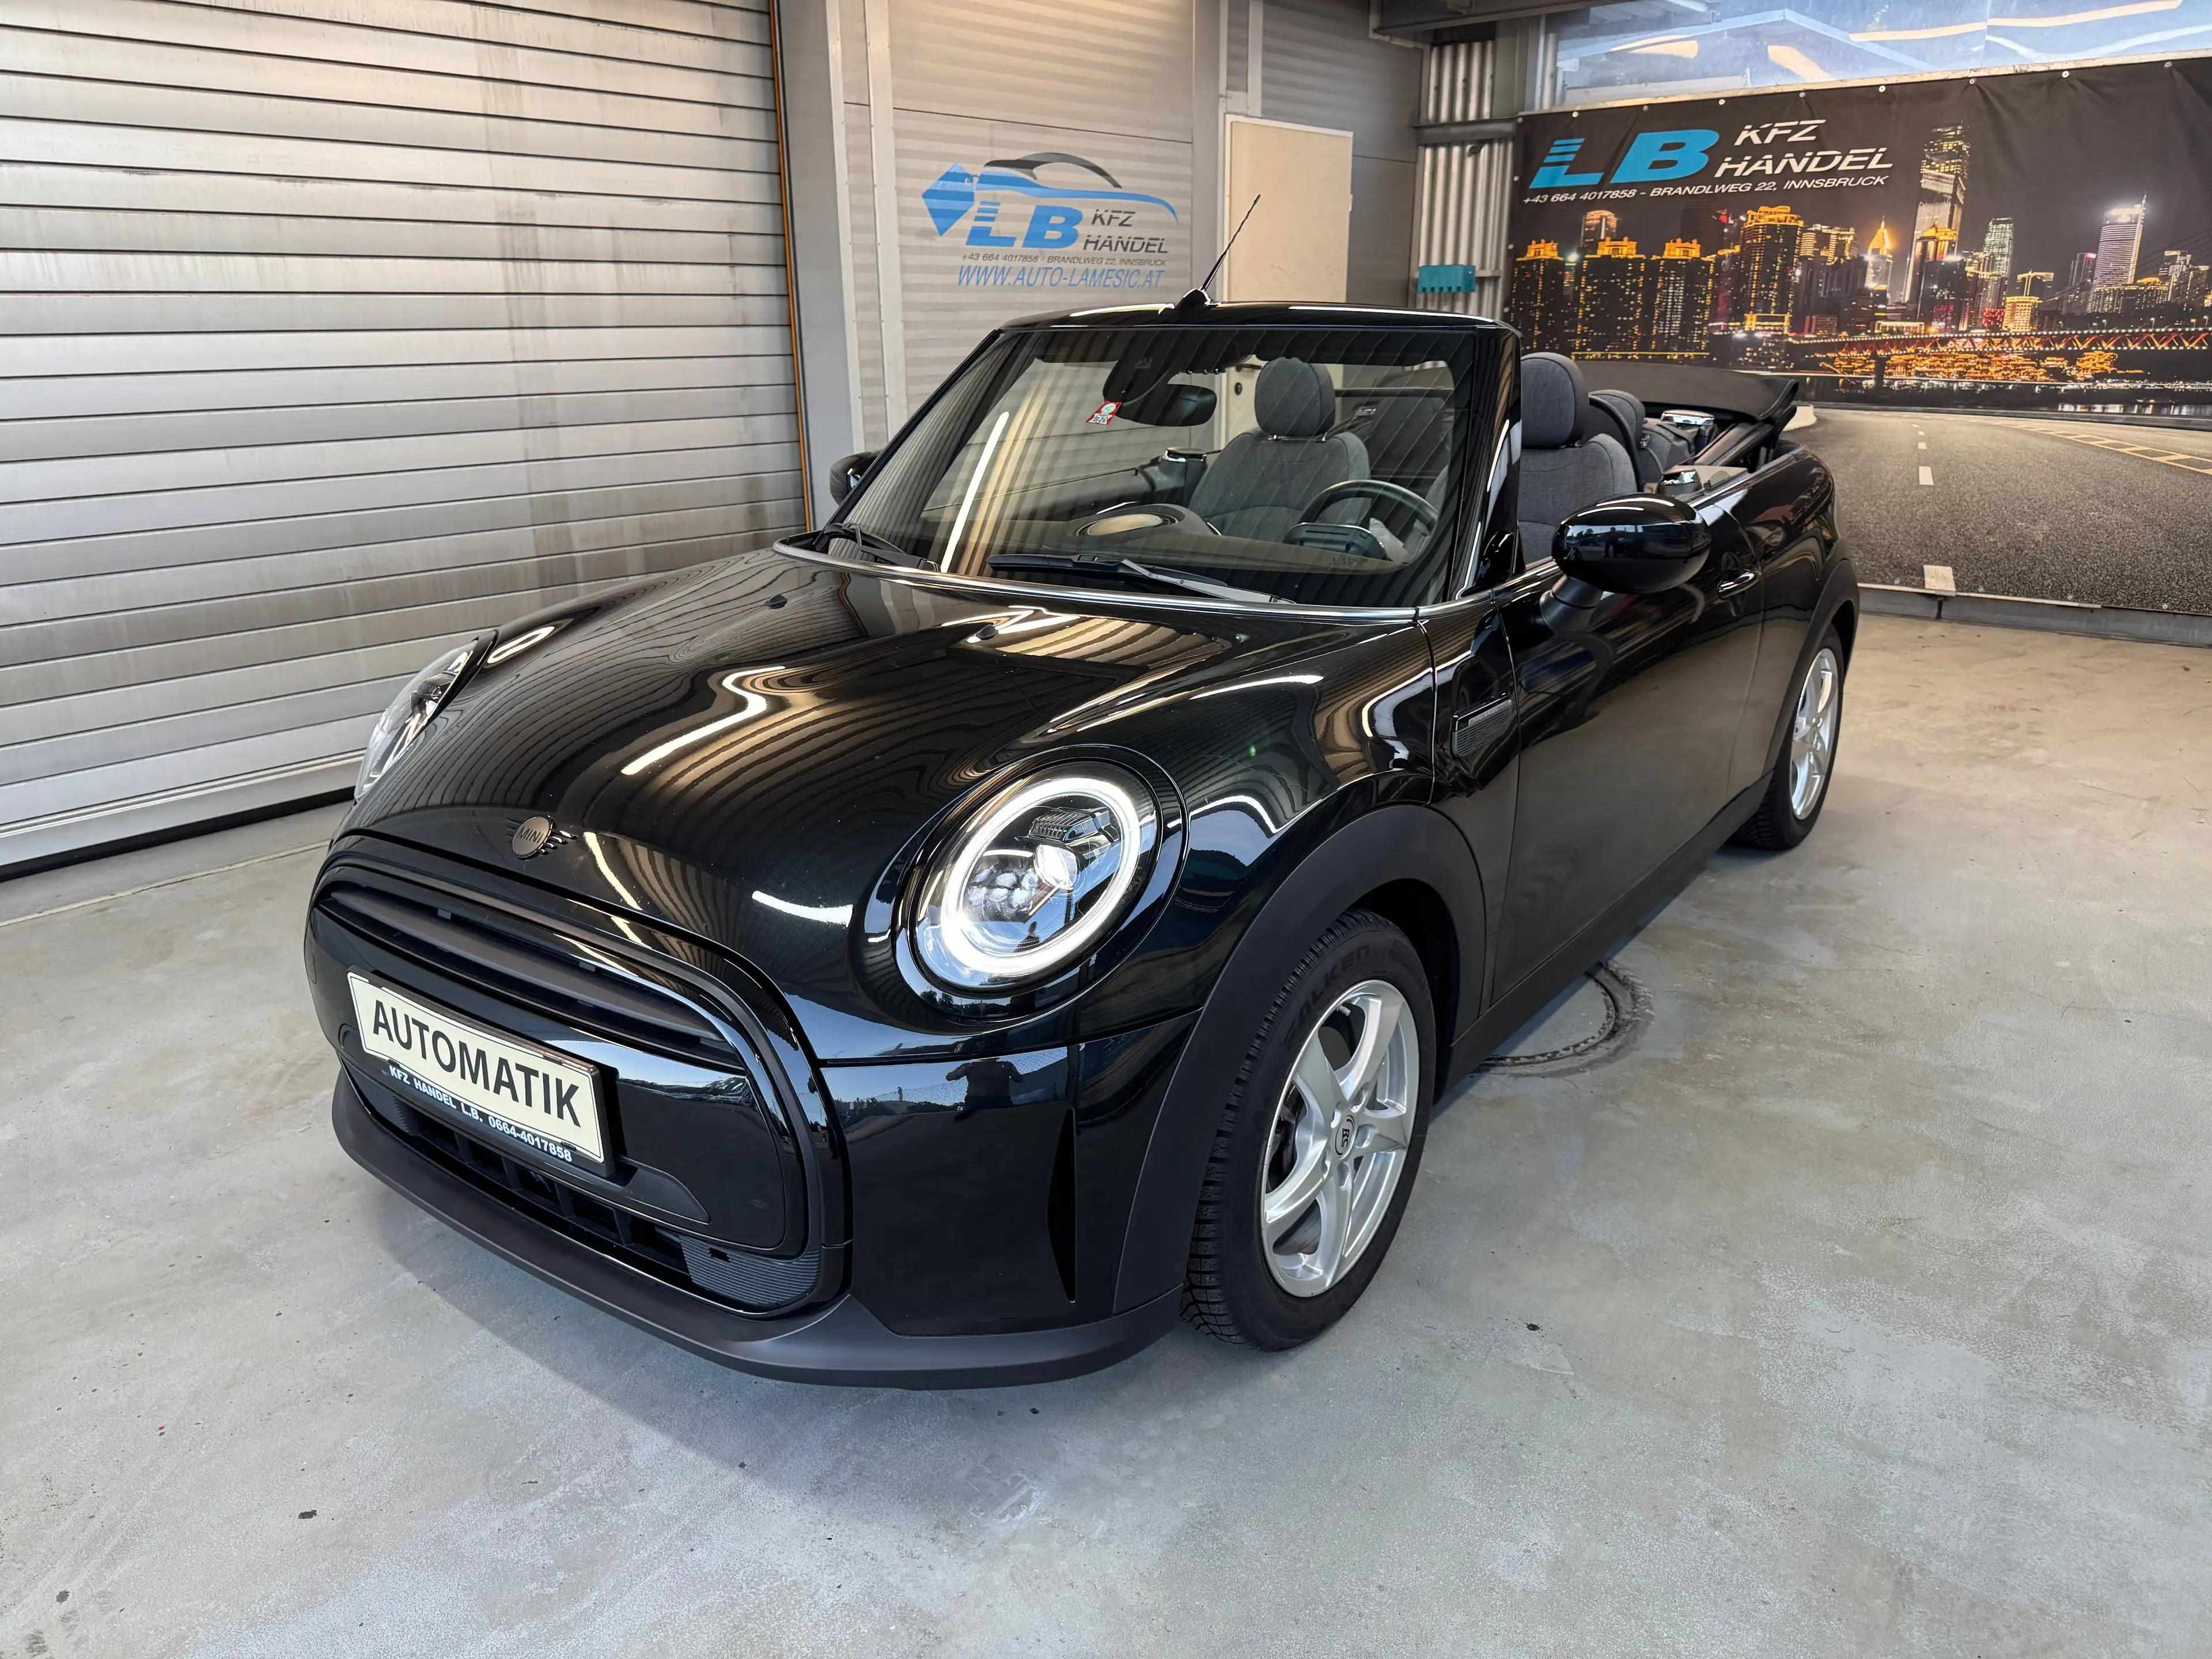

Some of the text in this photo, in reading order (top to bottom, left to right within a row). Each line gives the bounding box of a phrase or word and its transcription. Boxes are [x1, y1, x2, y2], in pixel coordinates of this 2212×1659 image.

[1733, 119, 1827, 146] KFZ
[1528, 129, 1719, 189] LB
[1714, 147, 1893, 177] HANDEL
[1523, 194, 1548, 203] +43
[1551, 193, 1577, 202] 664
[1579, 189, 1637, 200] 4017858
[1650, 181, 1752, 197] BRANDLWEG
[1754, 181, 1777, 192] 22,
[1783, 175, 1889, 190] INNSBRUCK
[965, 202, 1084, 249] LB
[1091, 209, 1136, 228] KFZ
[1083, 234, 1169, 254] HANDEL
[1047, 256, 1103, 265] BRANDLWEG
[1118, 258, 1166, 266] INNSBRUCK
[958, 265, 1165, 288] WWW.AUTO-LAMESIC.AT
[517, 826, 544, 844] MINI
[373, 999, 581, 1128] AUTOMATIK
[389, 1065, 572, 1162] KFZ HANDEL L.B. 0664-4017858
